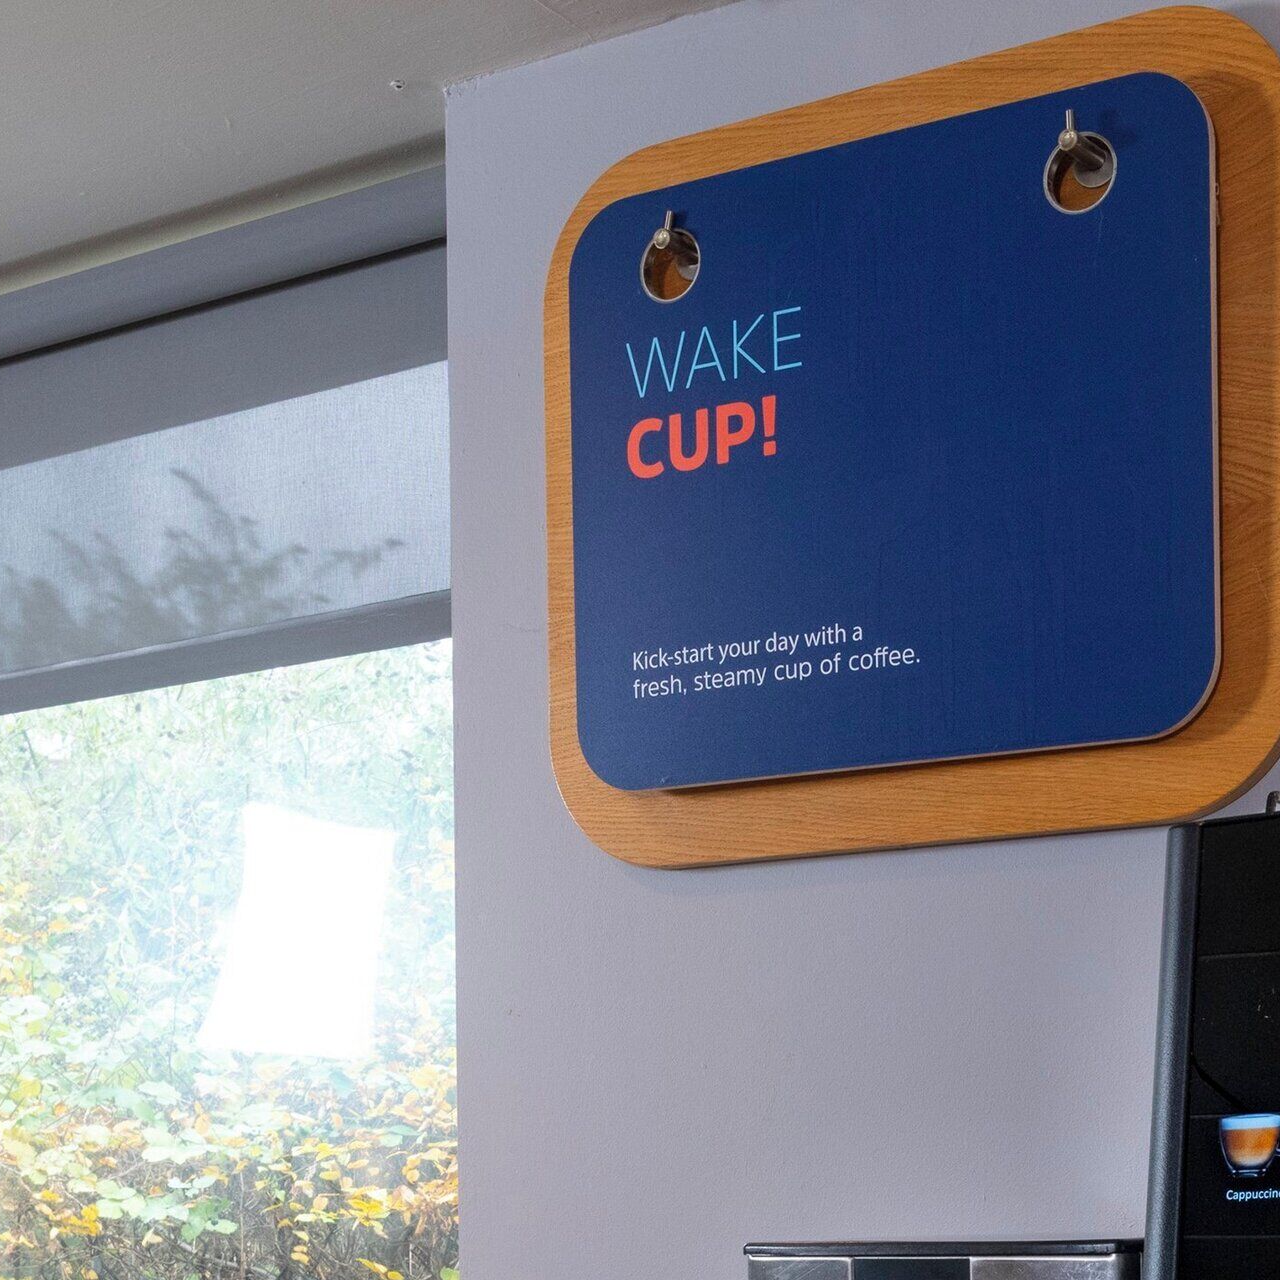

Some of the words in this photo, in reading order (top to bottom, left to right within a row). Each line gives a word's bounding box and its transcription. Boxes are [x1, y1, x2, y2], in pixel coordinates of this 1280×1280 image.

[626, 306, 803, 398] WAKE
[626, 395, 777, 479] CUP!
[633, 643, 714, 671] Kick-start
[718, 640, 761, 665] your
[765, 632, 799, 655] day
[804, 623, 846, 647] with
[852, 626, 863, 641] a
[633, 674, 688, 699] fresh,
[694, 666, 767, 692] steamy
[774, 659, 812, 681] cup
[820, 653, 841, 675] of
[848, 646, 920, 672] coffee.
